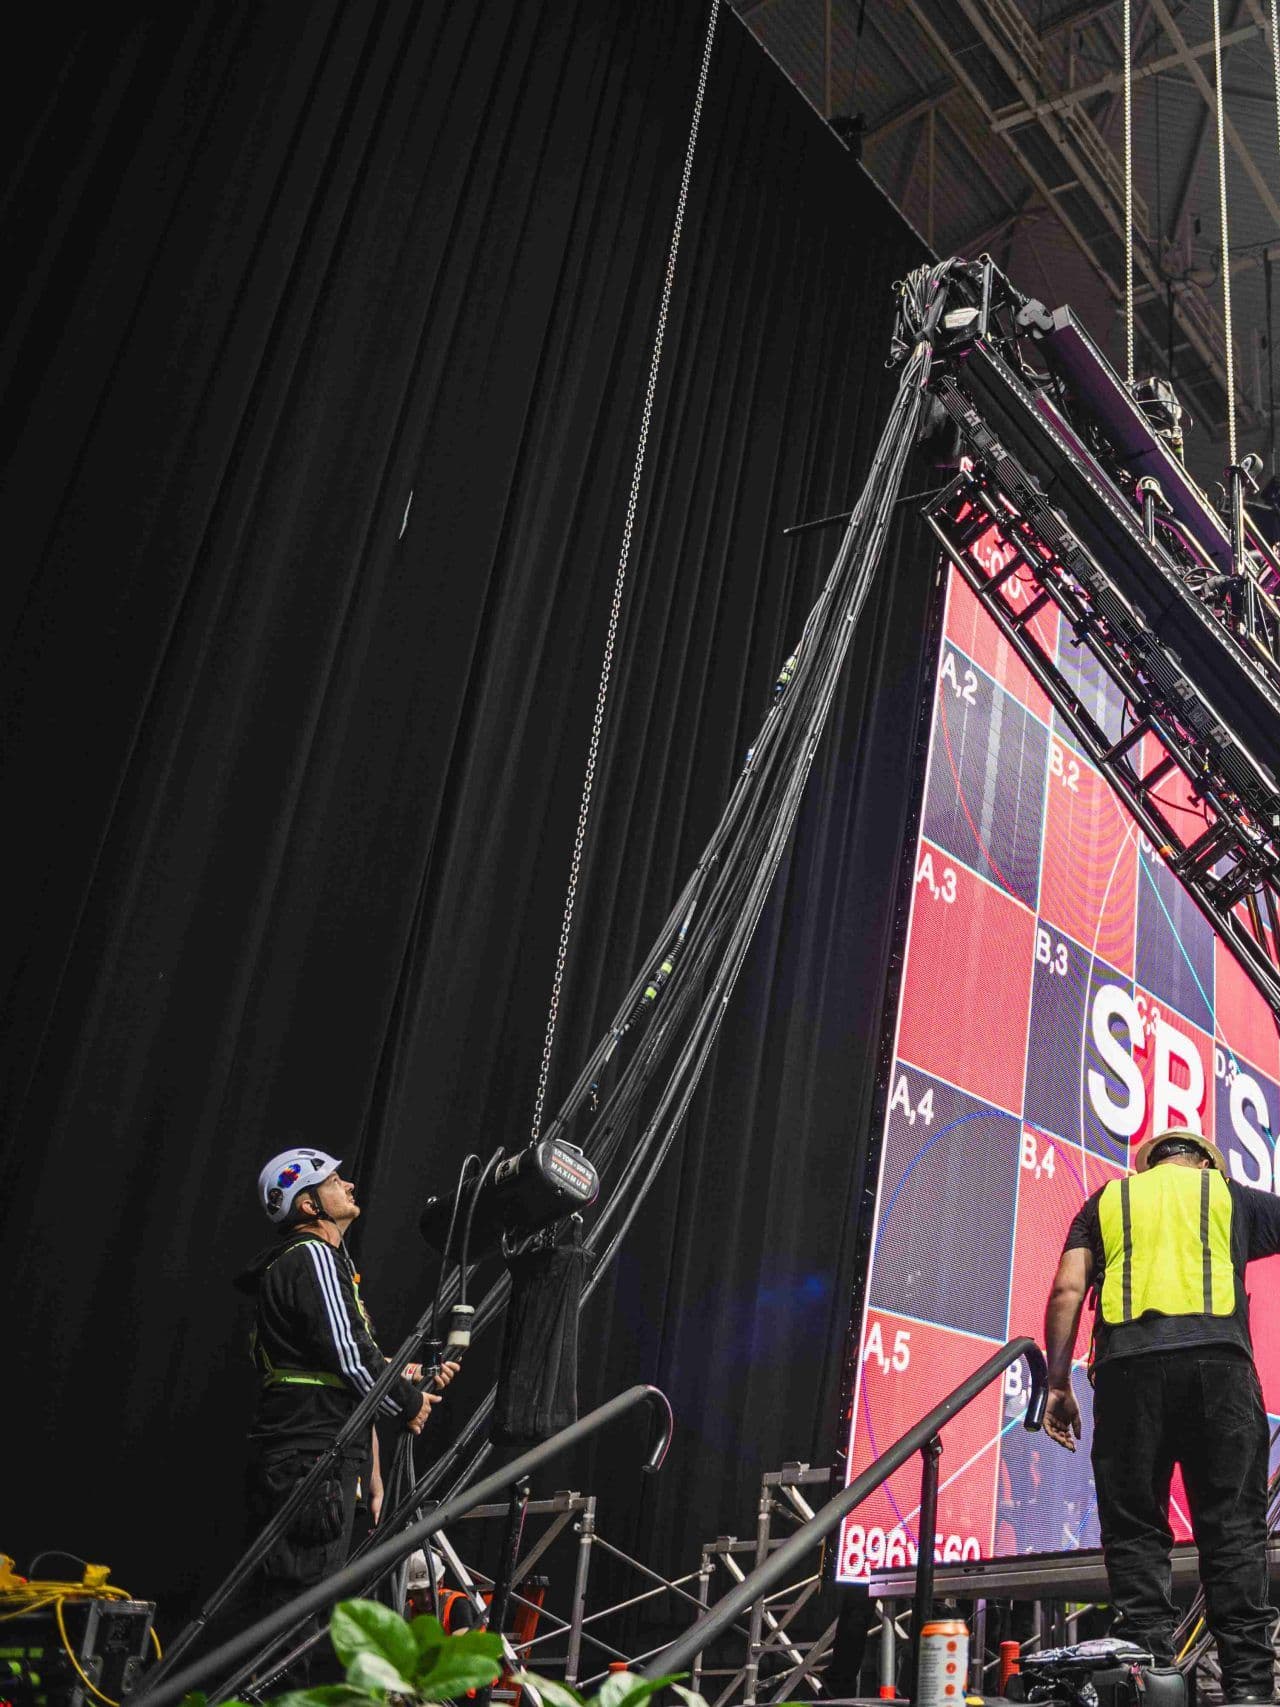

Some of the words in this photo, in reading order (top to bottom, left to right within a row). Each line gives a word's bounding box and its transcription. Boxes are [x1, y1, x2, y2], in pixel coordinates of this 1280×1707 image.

[941, 651, 978, 705] A,2
[1050, 743, 1079, 793] B,2
[917, 852, 957, 904] A,3
[1036, 927, 1068, 976] B,3
[890, 1074, 934, 1125] A,4
[550, 1161, 589, 1191] MAXIMUM
[1020, 1132, 1055, 1179] B,4
[862, 1321, 911, 1375] A,5
